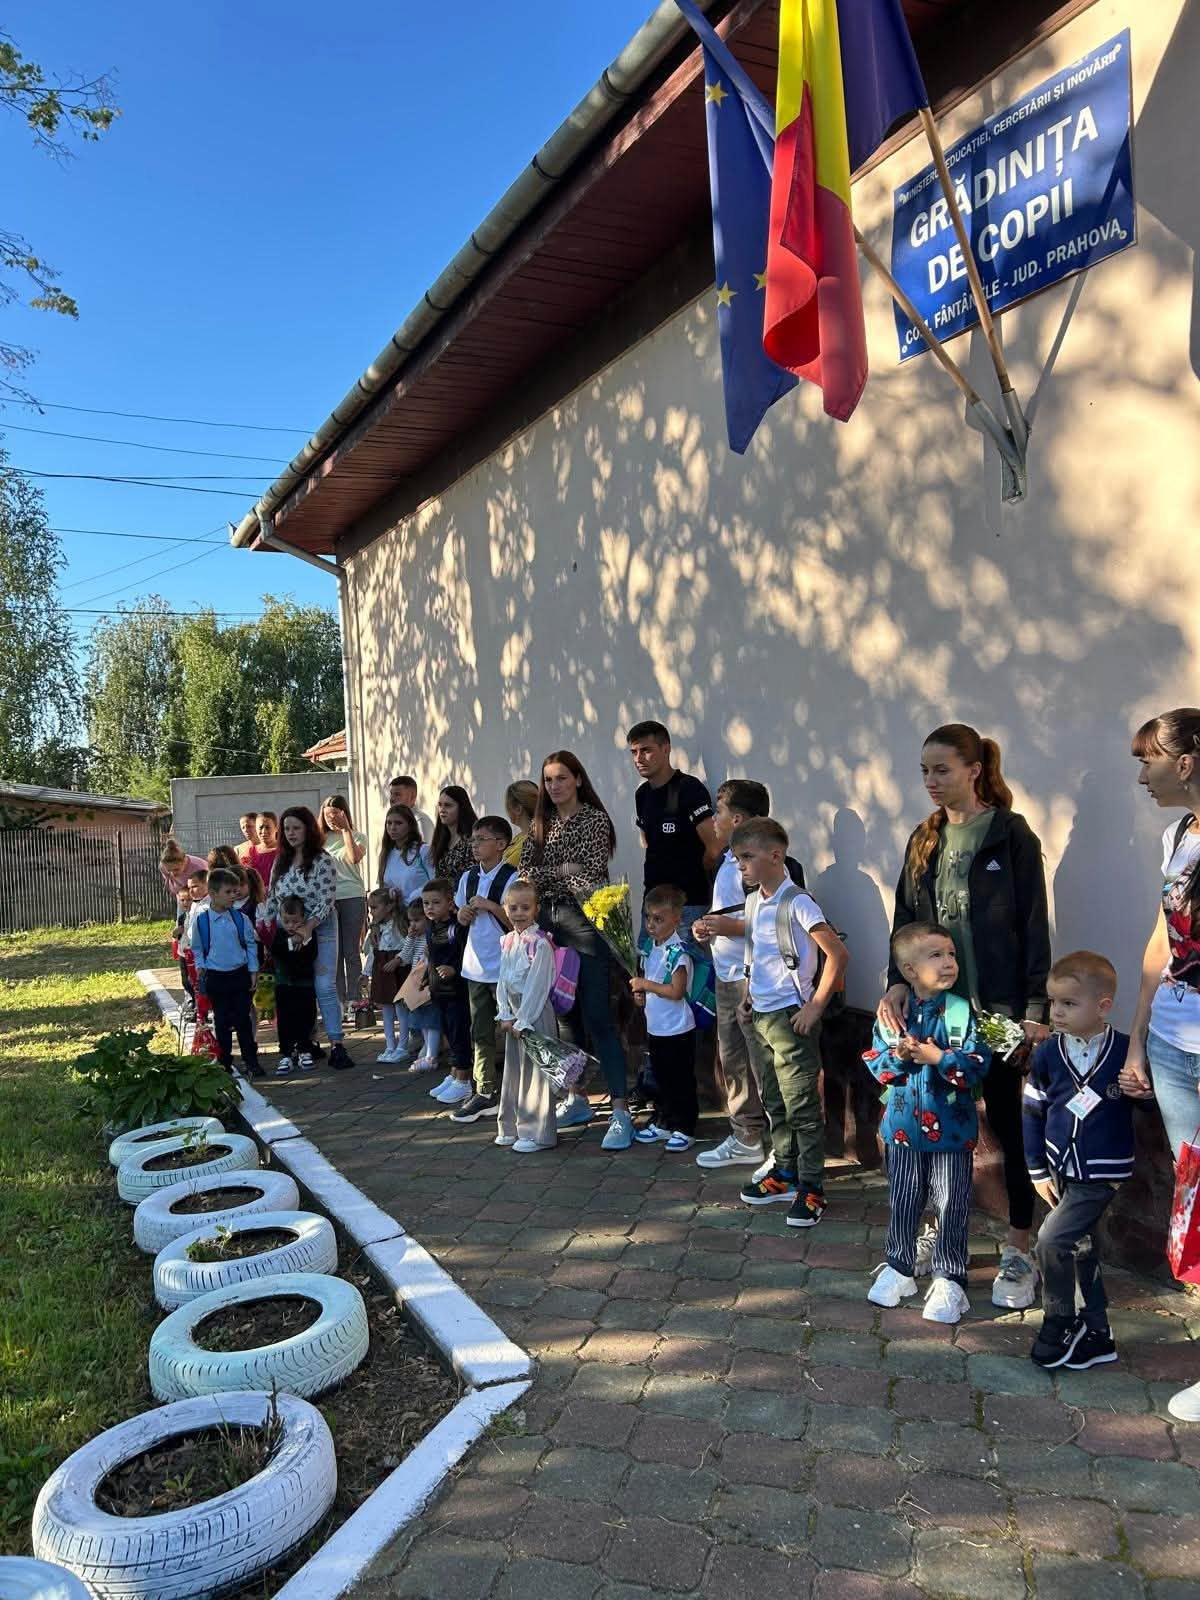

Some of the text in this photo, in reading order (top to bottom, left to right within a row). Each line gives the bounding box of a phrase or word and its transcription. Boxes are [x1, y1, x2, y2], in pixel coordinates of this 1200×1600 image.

[993, 91, 1051, 136] CERCETĂRII
[1067, 51, 1117, 91] INOVĂRII
[910, 105, 1098, 248] GRĂDINIȚA
[927, 178, 1073, 294] DE COPII
[905, 319, 932, 344] CO.
[934, 279, 1000, 328] FÂNTÂNLE
[1011, 260, 1042, 287] JUD.
[1046, 218, 1120, 268] PRAHOVA
